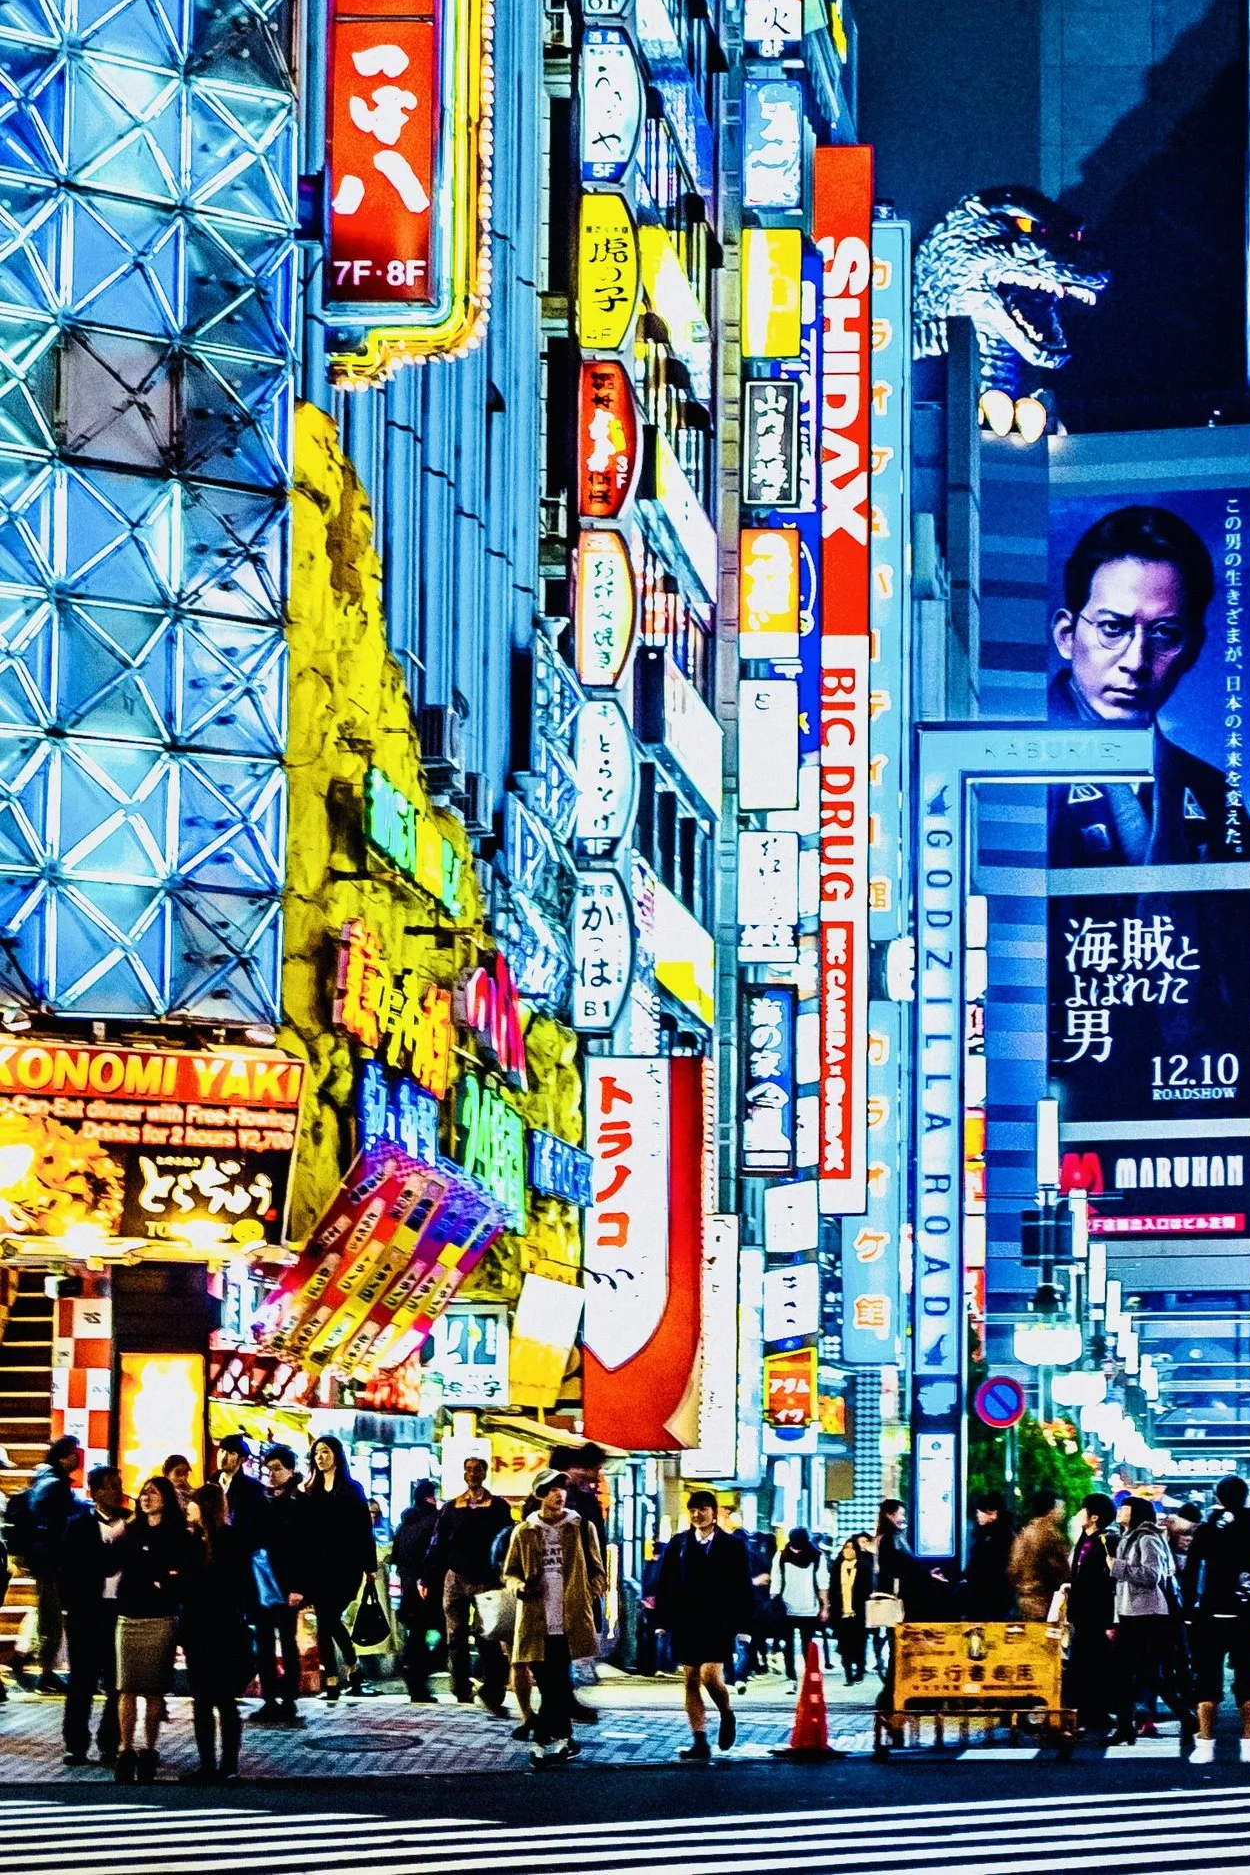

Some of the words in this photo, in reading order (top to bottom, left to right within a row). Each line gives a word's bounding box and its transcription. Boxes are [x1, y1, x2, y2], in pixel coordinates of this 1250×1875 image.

[332, 43, 430, 214] つぼ八
[821, 236, 871, 546] SHIDAX
[1224, 498, 1243, 855] この男の生きざまが、日本の未来を変えた。
[821, 668, 856, 747] BIC
[582, 838, 612, 855] 1F
[820, 765, 855, 902] DRUG
[1064, 915, 1201, 973] 海賊と
[583, 1001, 611, 1018] B1
[925, 829, 954, 1133] GODZILLA
[1064, 972, 1190, 1007] よばれた
[1062, 1009, 1114, 1063] 男
[192, 1057, 301, 1105] YAKI
[1151, 1053, 1240, 1087] 12.10
[1152, 1087, 1238, 1101] ROADSHOW
[596, 1076, 634, 1248] トラノコ
[1114, 1155, 1245, 1189] MARUHAN
[924, 1173, 952, 1317] ROAD
